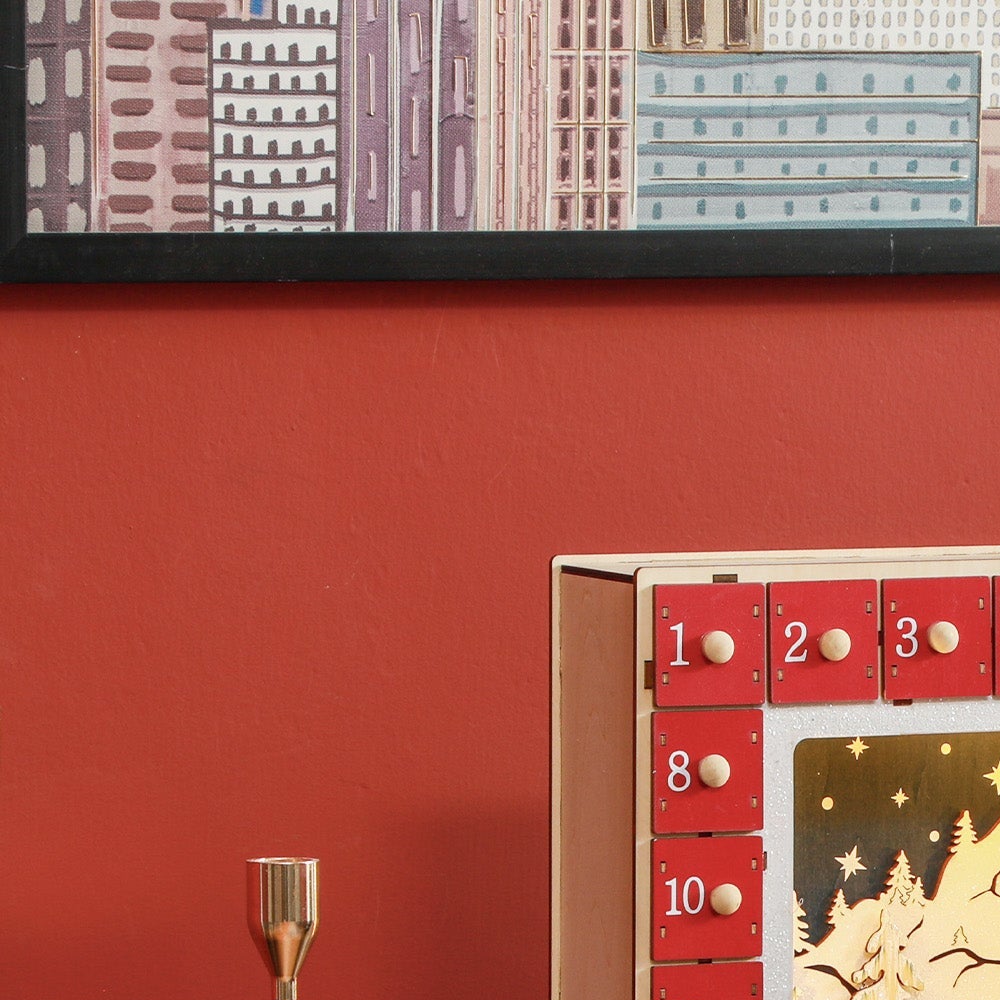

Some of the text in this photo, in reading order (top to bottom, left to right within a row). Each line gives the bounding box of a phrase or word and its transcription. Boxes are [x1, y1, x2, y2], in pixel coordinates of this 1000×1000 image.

[670, 622, 689, 665] 1
[785, 622, 807, 662] 2
[896, 617, 918, 657] 3
[668, 751, 690, 791] 8
[665, 877, 704, 915] 10
